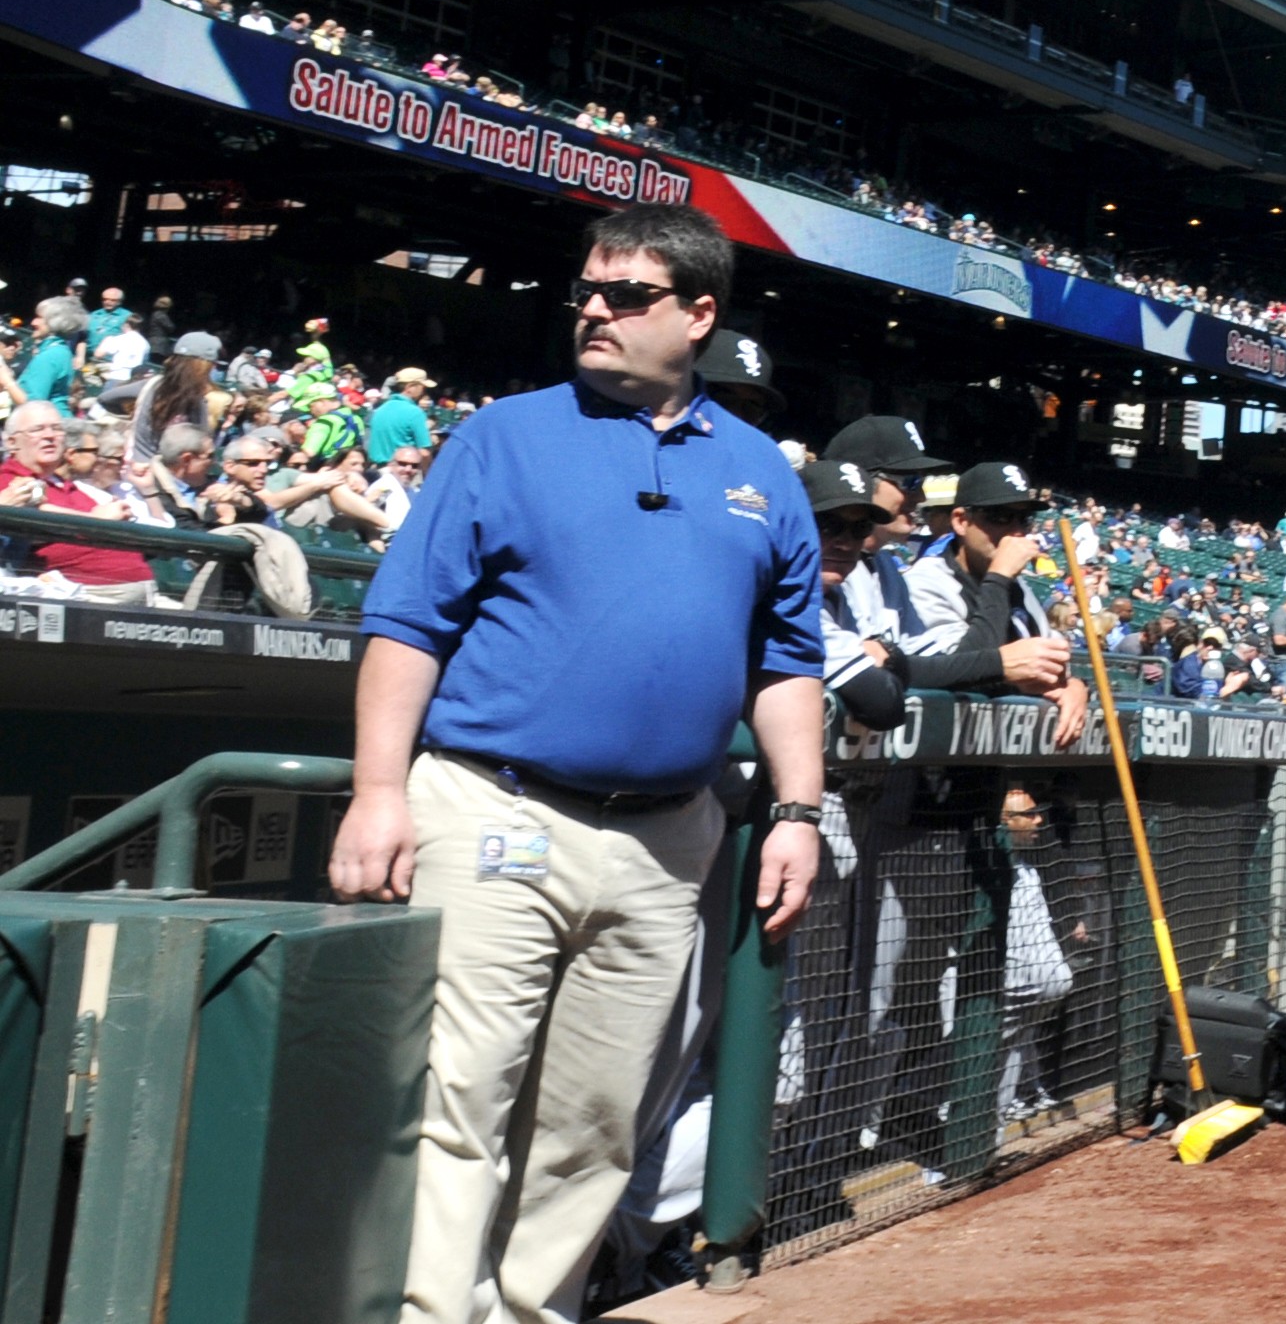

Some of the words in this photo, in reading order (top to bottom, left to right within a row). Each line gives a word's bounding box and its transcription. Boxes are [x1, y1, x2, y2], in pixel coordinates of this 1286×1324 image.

[290, 58, 395, 133] Salute
[397, 91, 433, 144] to
[432, 101, 539, 173] Armed
[538, 129, 637, 200] Forces
[636, 158, 691, 206] Day
[1226, 329, 1271, 374] Salute
[104, 620, 225, 649] neweracap.com
